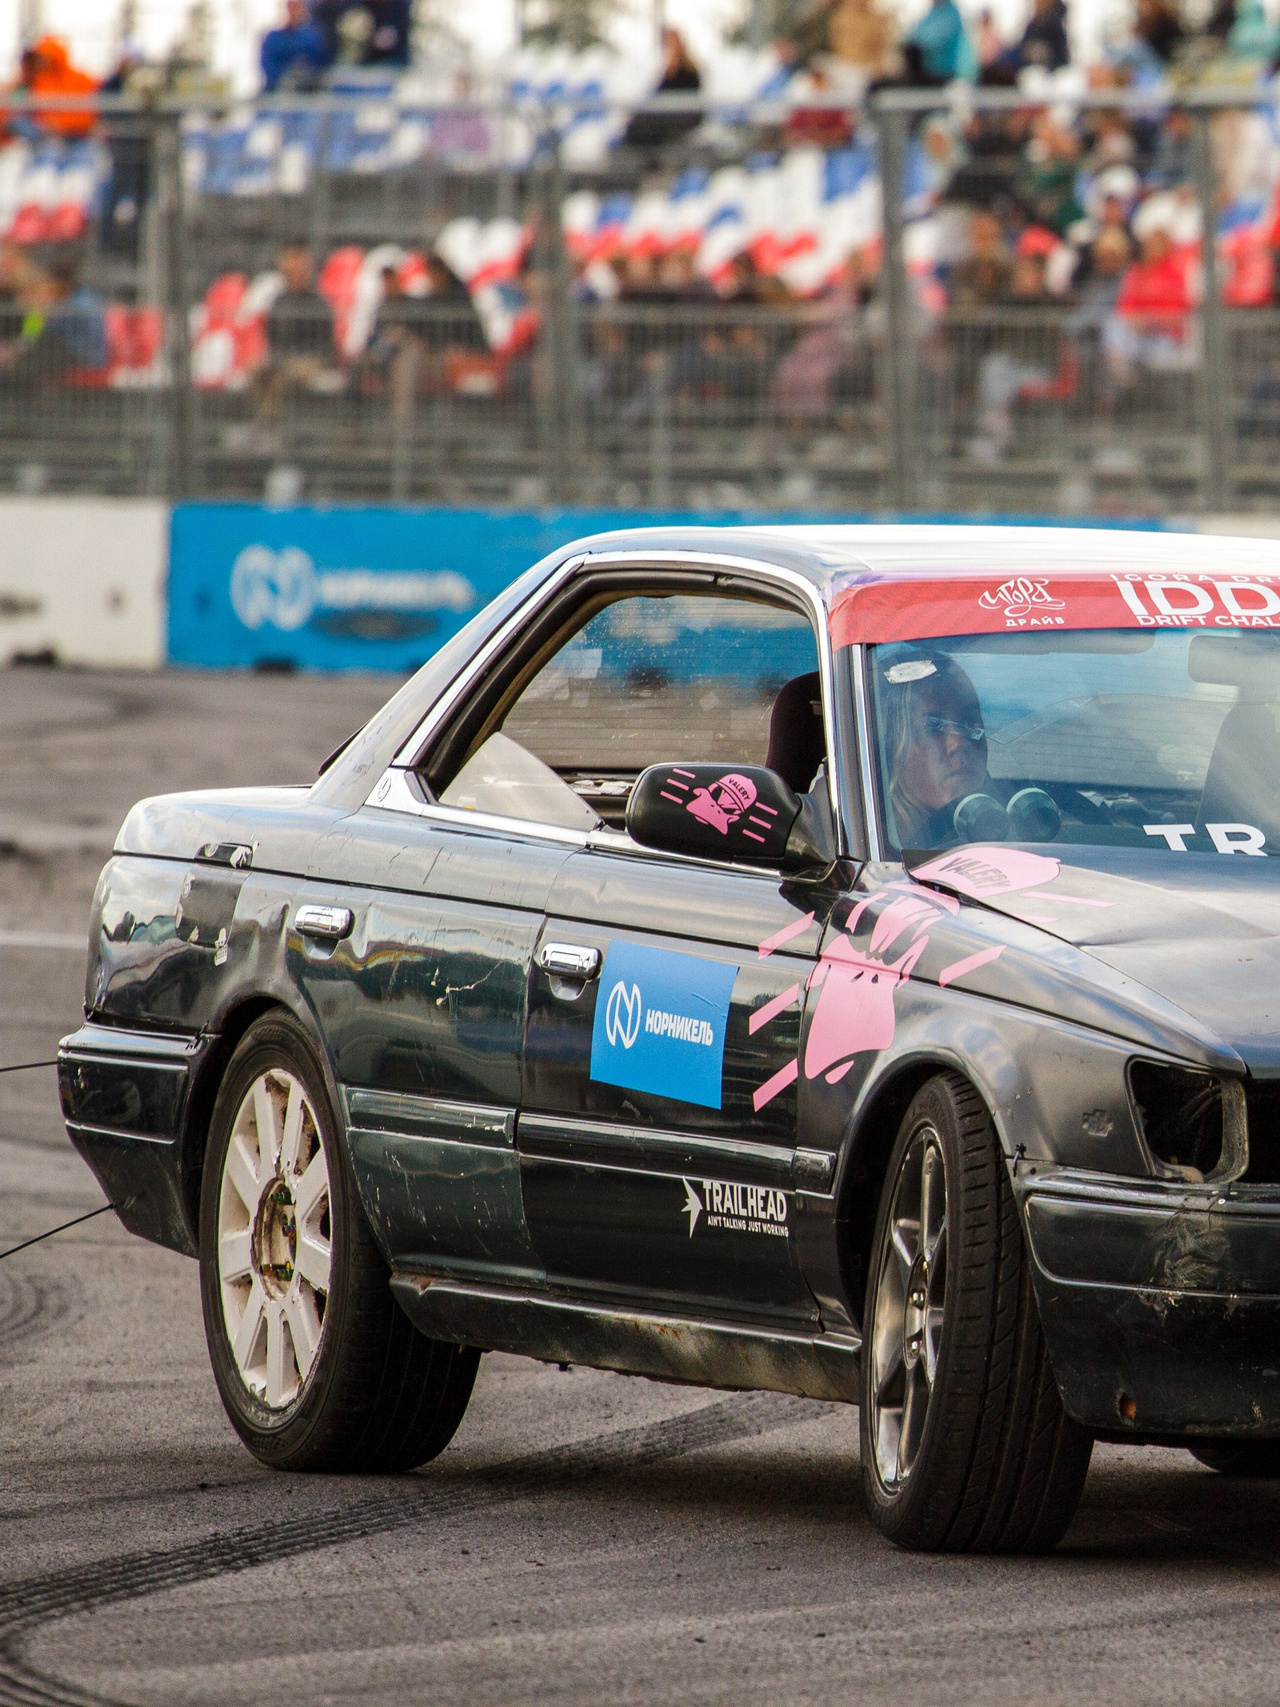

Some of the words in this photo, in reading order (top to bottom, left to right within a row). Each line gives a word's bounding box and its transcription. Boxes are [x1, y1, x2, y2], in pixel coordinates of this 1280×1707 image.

[1109, 573, 1217, 582] IGORA
[1005, 615, 1066, 628] ДРАЙВ
[1135, 614, 1207, 626] DRIFT
[728, 778, 751, 800] VALERY
[937, 857, 1012, 890] VALERY
[645, 1008, 715, 1047] НОРНИКЕЛЬ
[702, 1180, 788, 1223] TRAILHEAD
[723, 1216, 747, 1232] TALKING
[748, 1220, 761, 1234] JUST
[762, 1222, 789, 1238] WORKING
